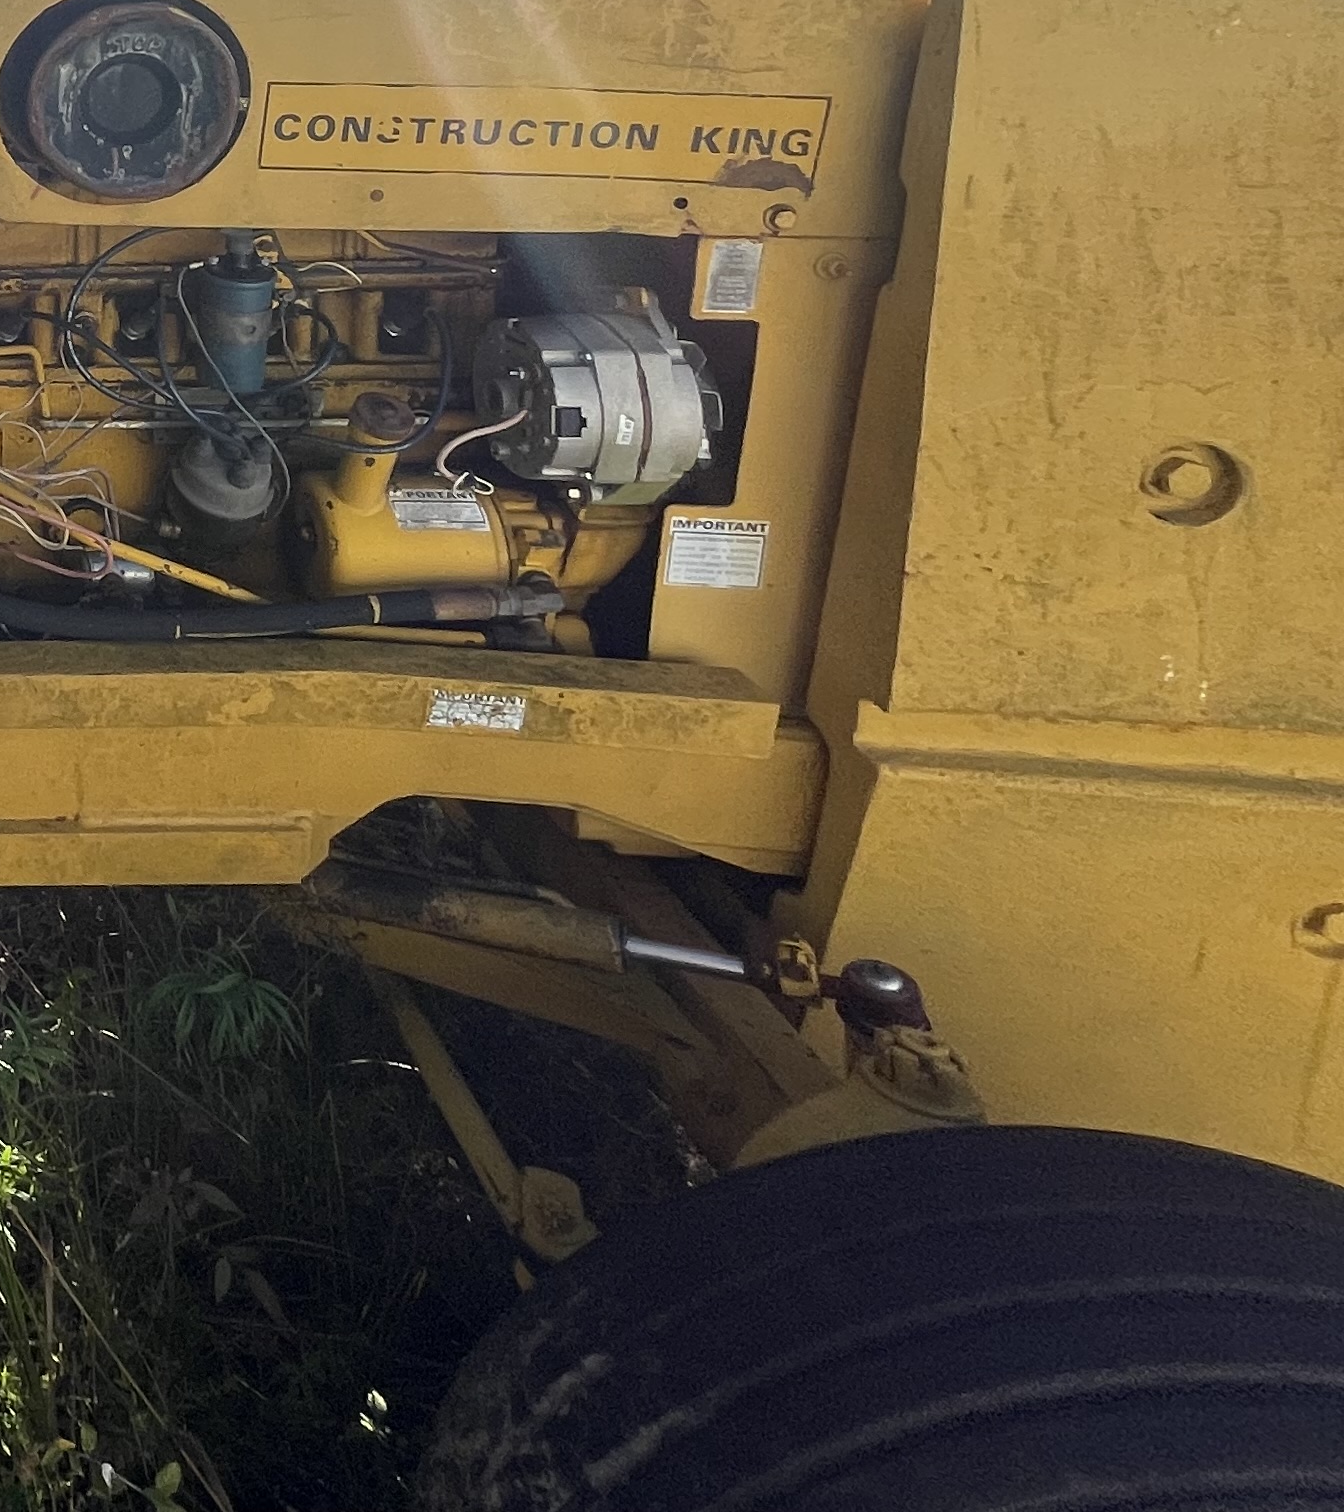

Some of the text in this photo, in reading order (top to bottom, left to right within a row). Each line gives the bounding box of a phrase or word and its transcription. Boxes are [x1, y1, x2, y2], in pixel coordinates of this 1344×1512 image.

[273, 113, 813, 158] CONSTRUCTION KING
[672, 519, 768, 533] IMPORTANT
